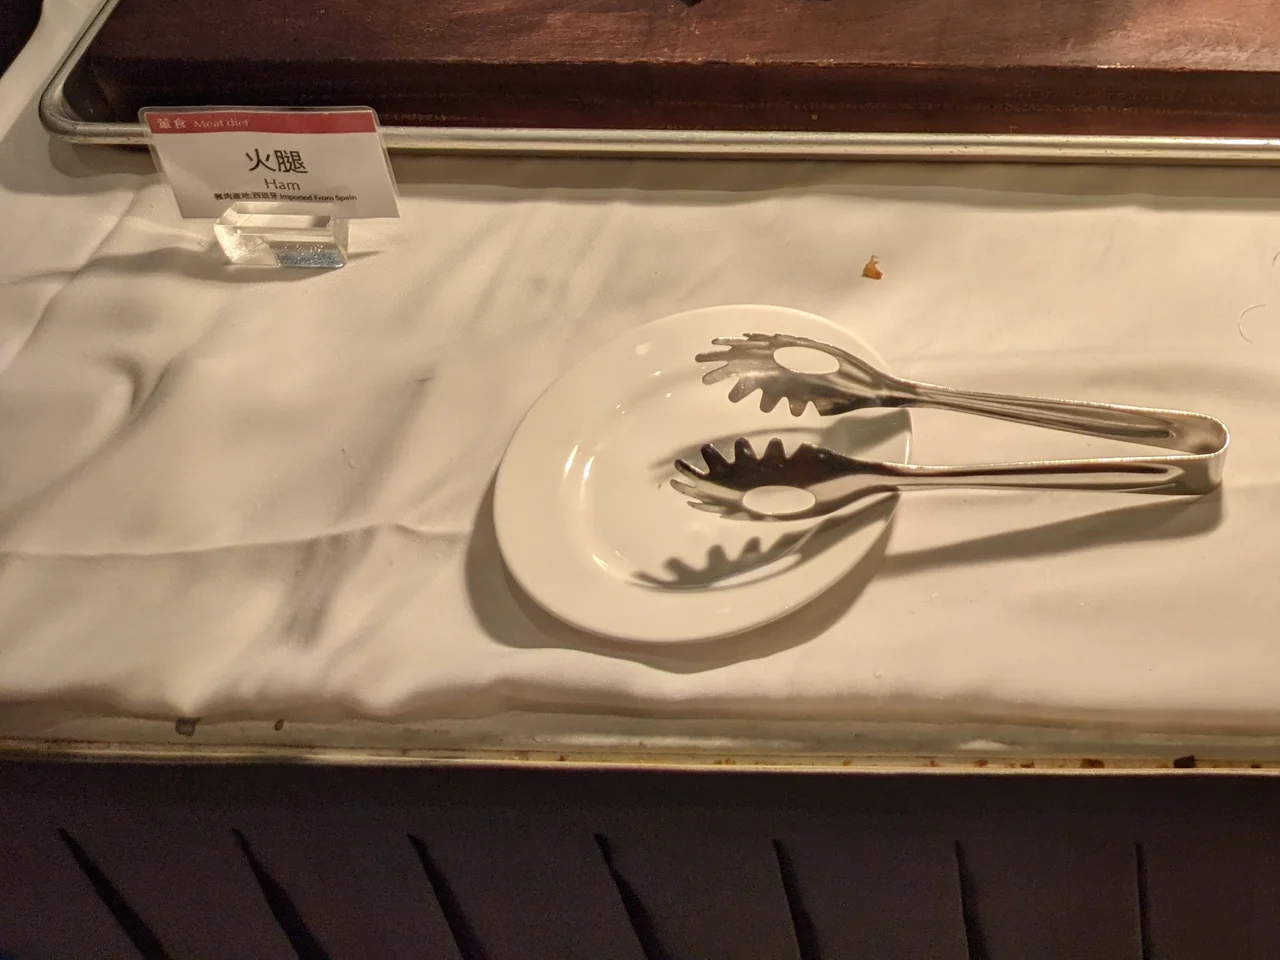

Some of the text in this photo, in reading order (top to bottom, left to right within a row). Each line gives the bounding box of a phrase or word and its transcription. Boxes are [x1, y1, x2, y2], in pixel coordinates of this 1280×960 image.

[193, 119, 224, 128] Meat
[226, 117, 249, 128] diet
[245, 148, 308, 174] 火腿
[264, 178, 301, 191] Ham
[279, 193, 313, 202] Imported
[335, 194, 358, 202] Spain
